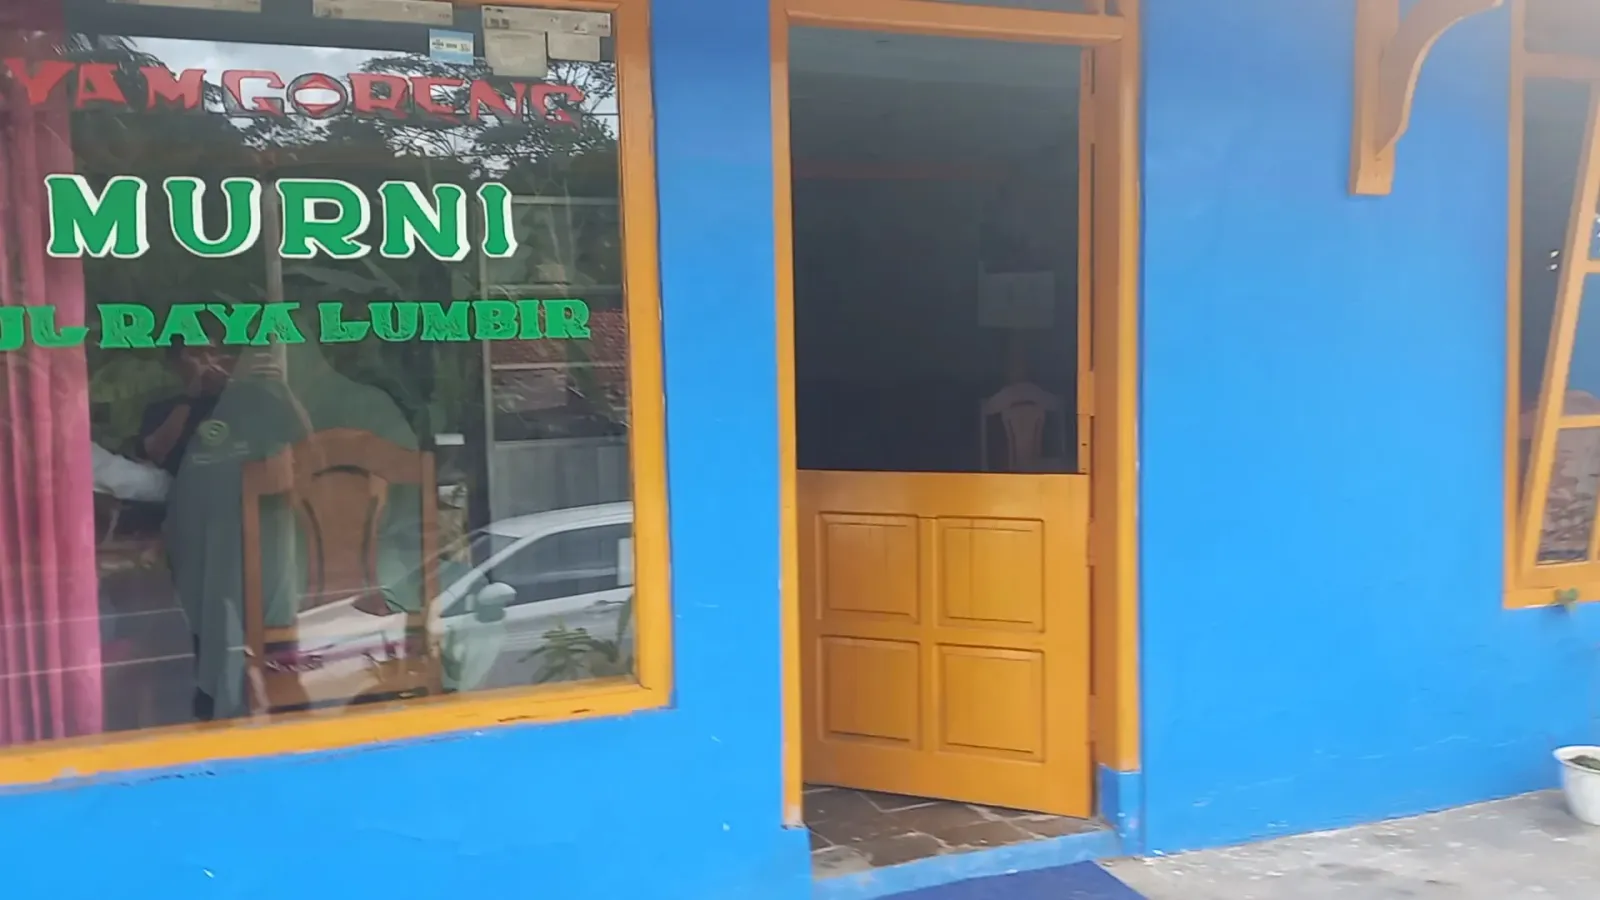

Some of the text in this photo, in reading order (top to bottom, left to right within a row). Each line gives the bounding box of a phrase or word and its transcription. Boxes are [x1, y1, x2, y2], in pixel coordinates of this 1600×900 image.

[221, 69, 585, 128] GORENG
[45, 174, 518, 262] MURNI
[97, 302, 306, 349] RAYA
[318, 299, 591, 343] LUMBIR
